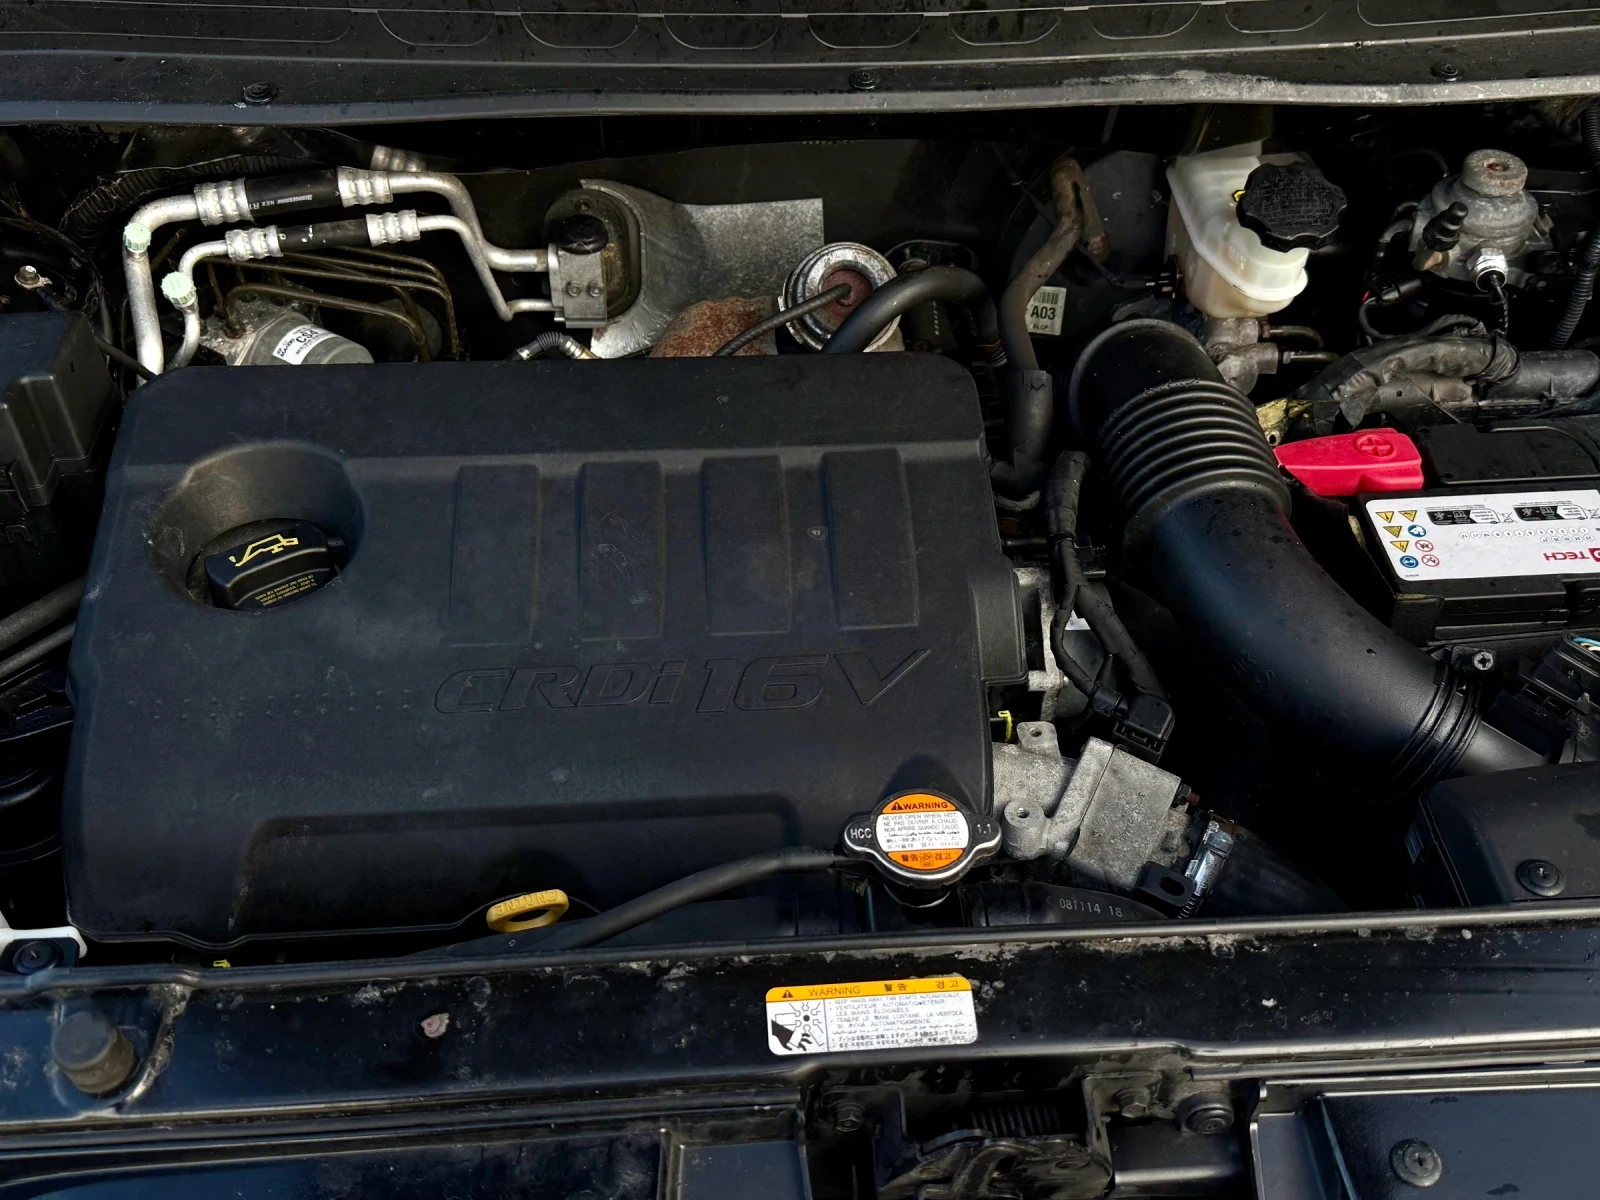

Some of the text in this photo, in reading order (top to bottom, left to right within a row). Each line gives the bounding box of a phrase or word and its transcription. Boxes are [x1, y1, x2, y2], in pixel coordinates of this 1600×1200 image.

[1030, 306, 1056, 320] A03
[1543, 552, 1589, 561] TECH
[434, 649, 932, 714] CRDi 16V
[903, 802, 948, 810] WARNING
[851, 828, 872, 839] HCC
[977, 823, 991, 834] 1.1
[494, 890, 557, 915] ENGINE
[1059, 898, 1123, 917] 081114 18
[809, 986, 861, 997] WARNING
